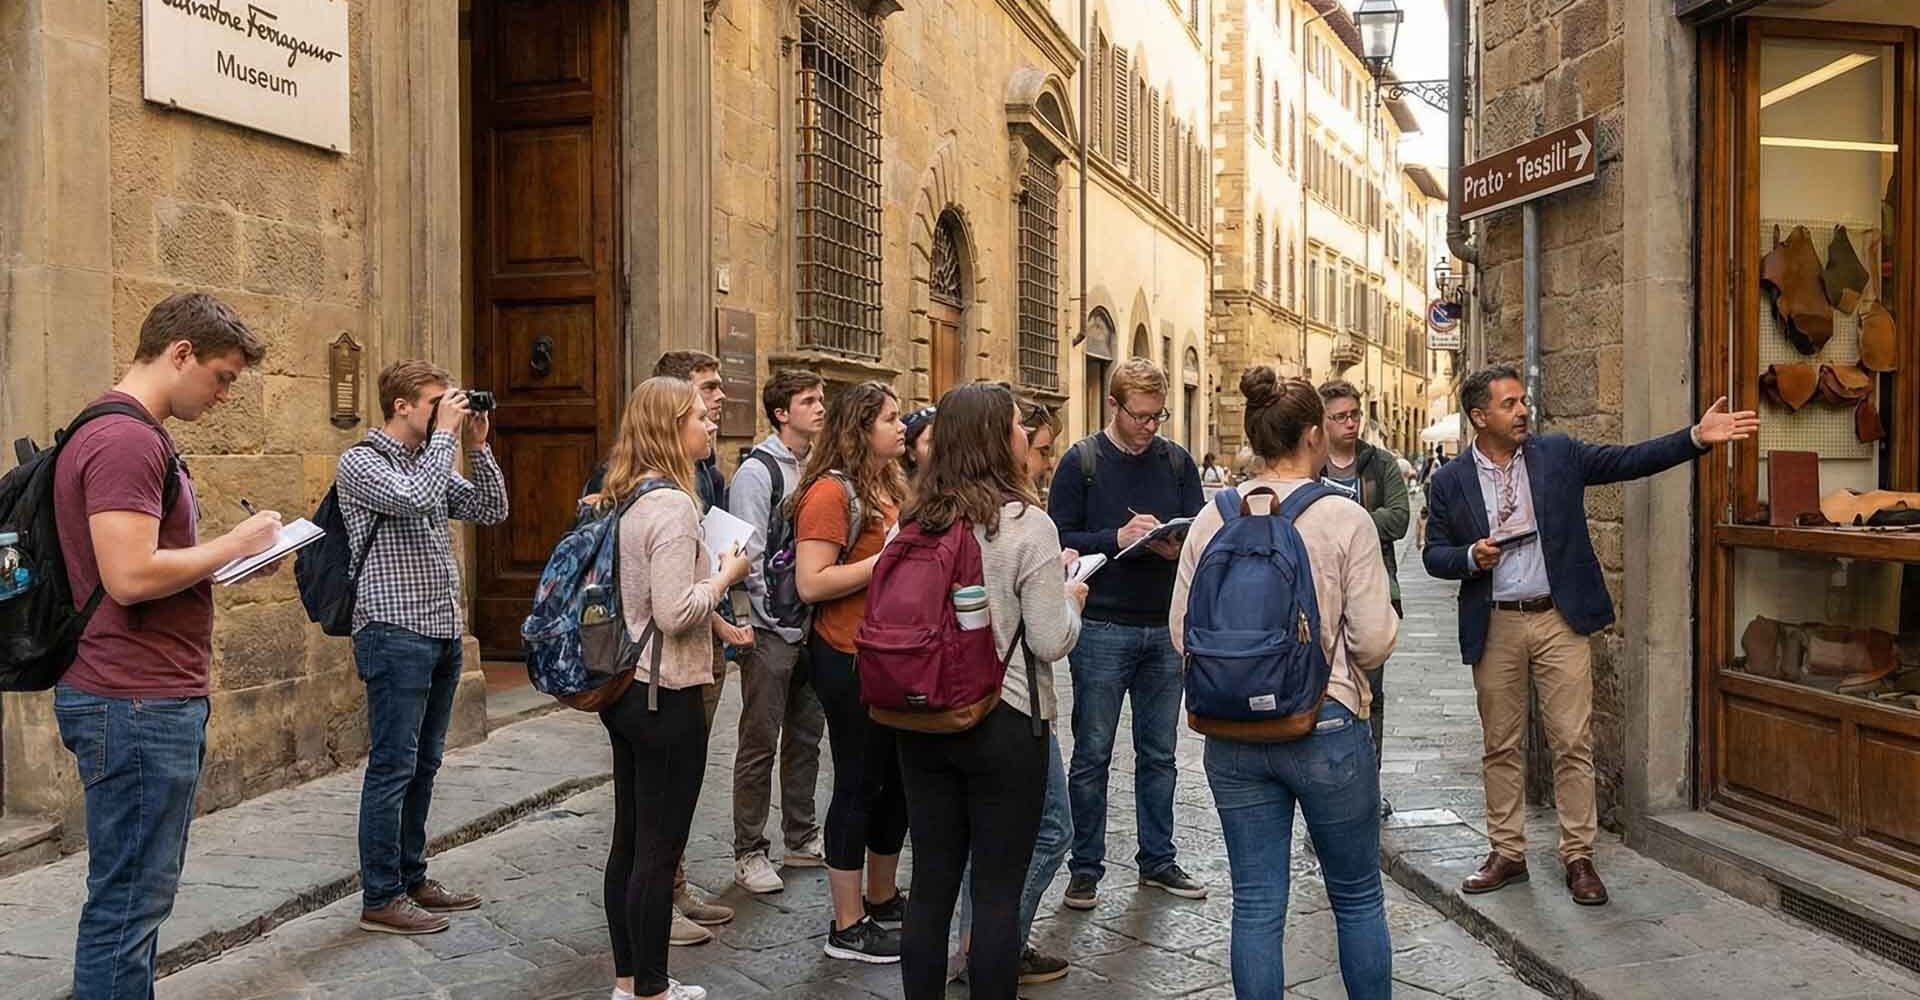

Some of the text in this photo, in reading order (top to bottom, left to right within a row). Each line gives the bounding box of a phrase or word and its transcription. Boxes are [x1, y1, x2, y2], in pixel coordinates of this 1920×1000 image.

[162, 0, 343, 68] alvatore Ferragamo
[217, 50, 297, 97] Museum
[1464, 168, 1504, 202] Prato
[1516, 139, 1566, 184] Tessili
